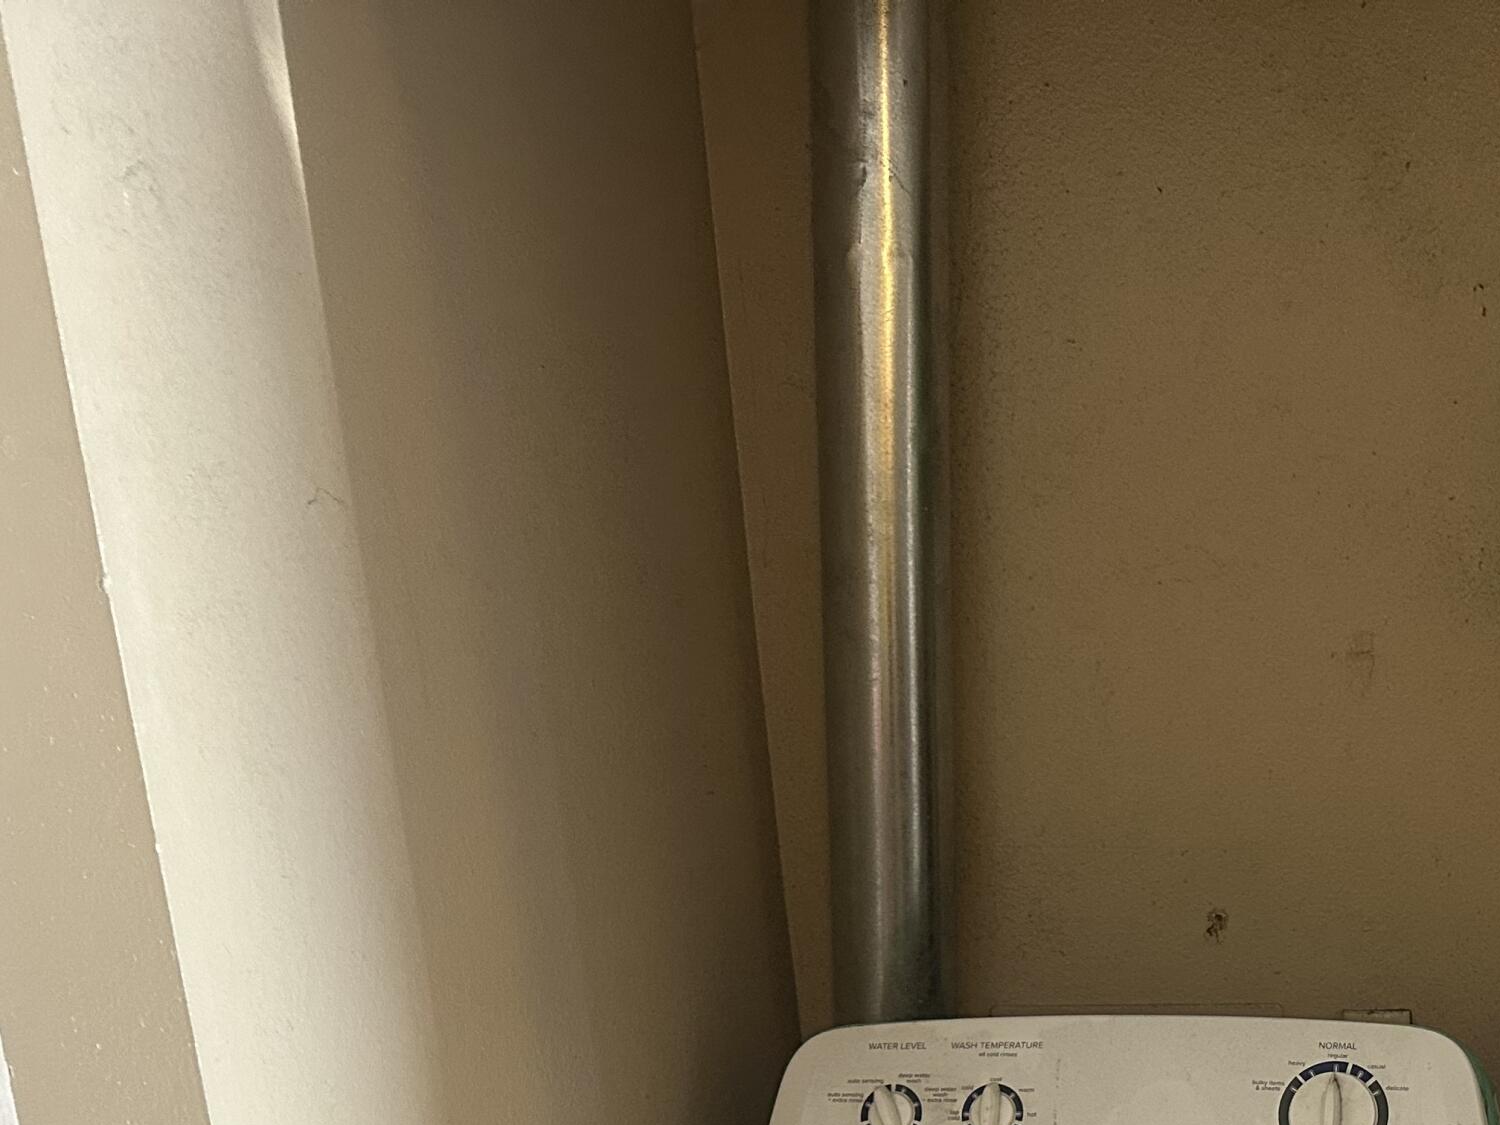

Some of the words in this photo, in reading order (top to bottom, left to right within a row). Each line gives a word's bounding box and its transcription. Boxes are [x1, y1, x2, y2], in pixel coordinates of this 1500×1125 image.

[868, 1042, 898, 1050] WATER
[901, 1041, 927, 1050] LEVEL
[951, 1041, 978, 1050] WASH
[980, 1041, 1044, 1050] TEMPERATURE
[1318, 1042, 1357, 1050] NORMAL
